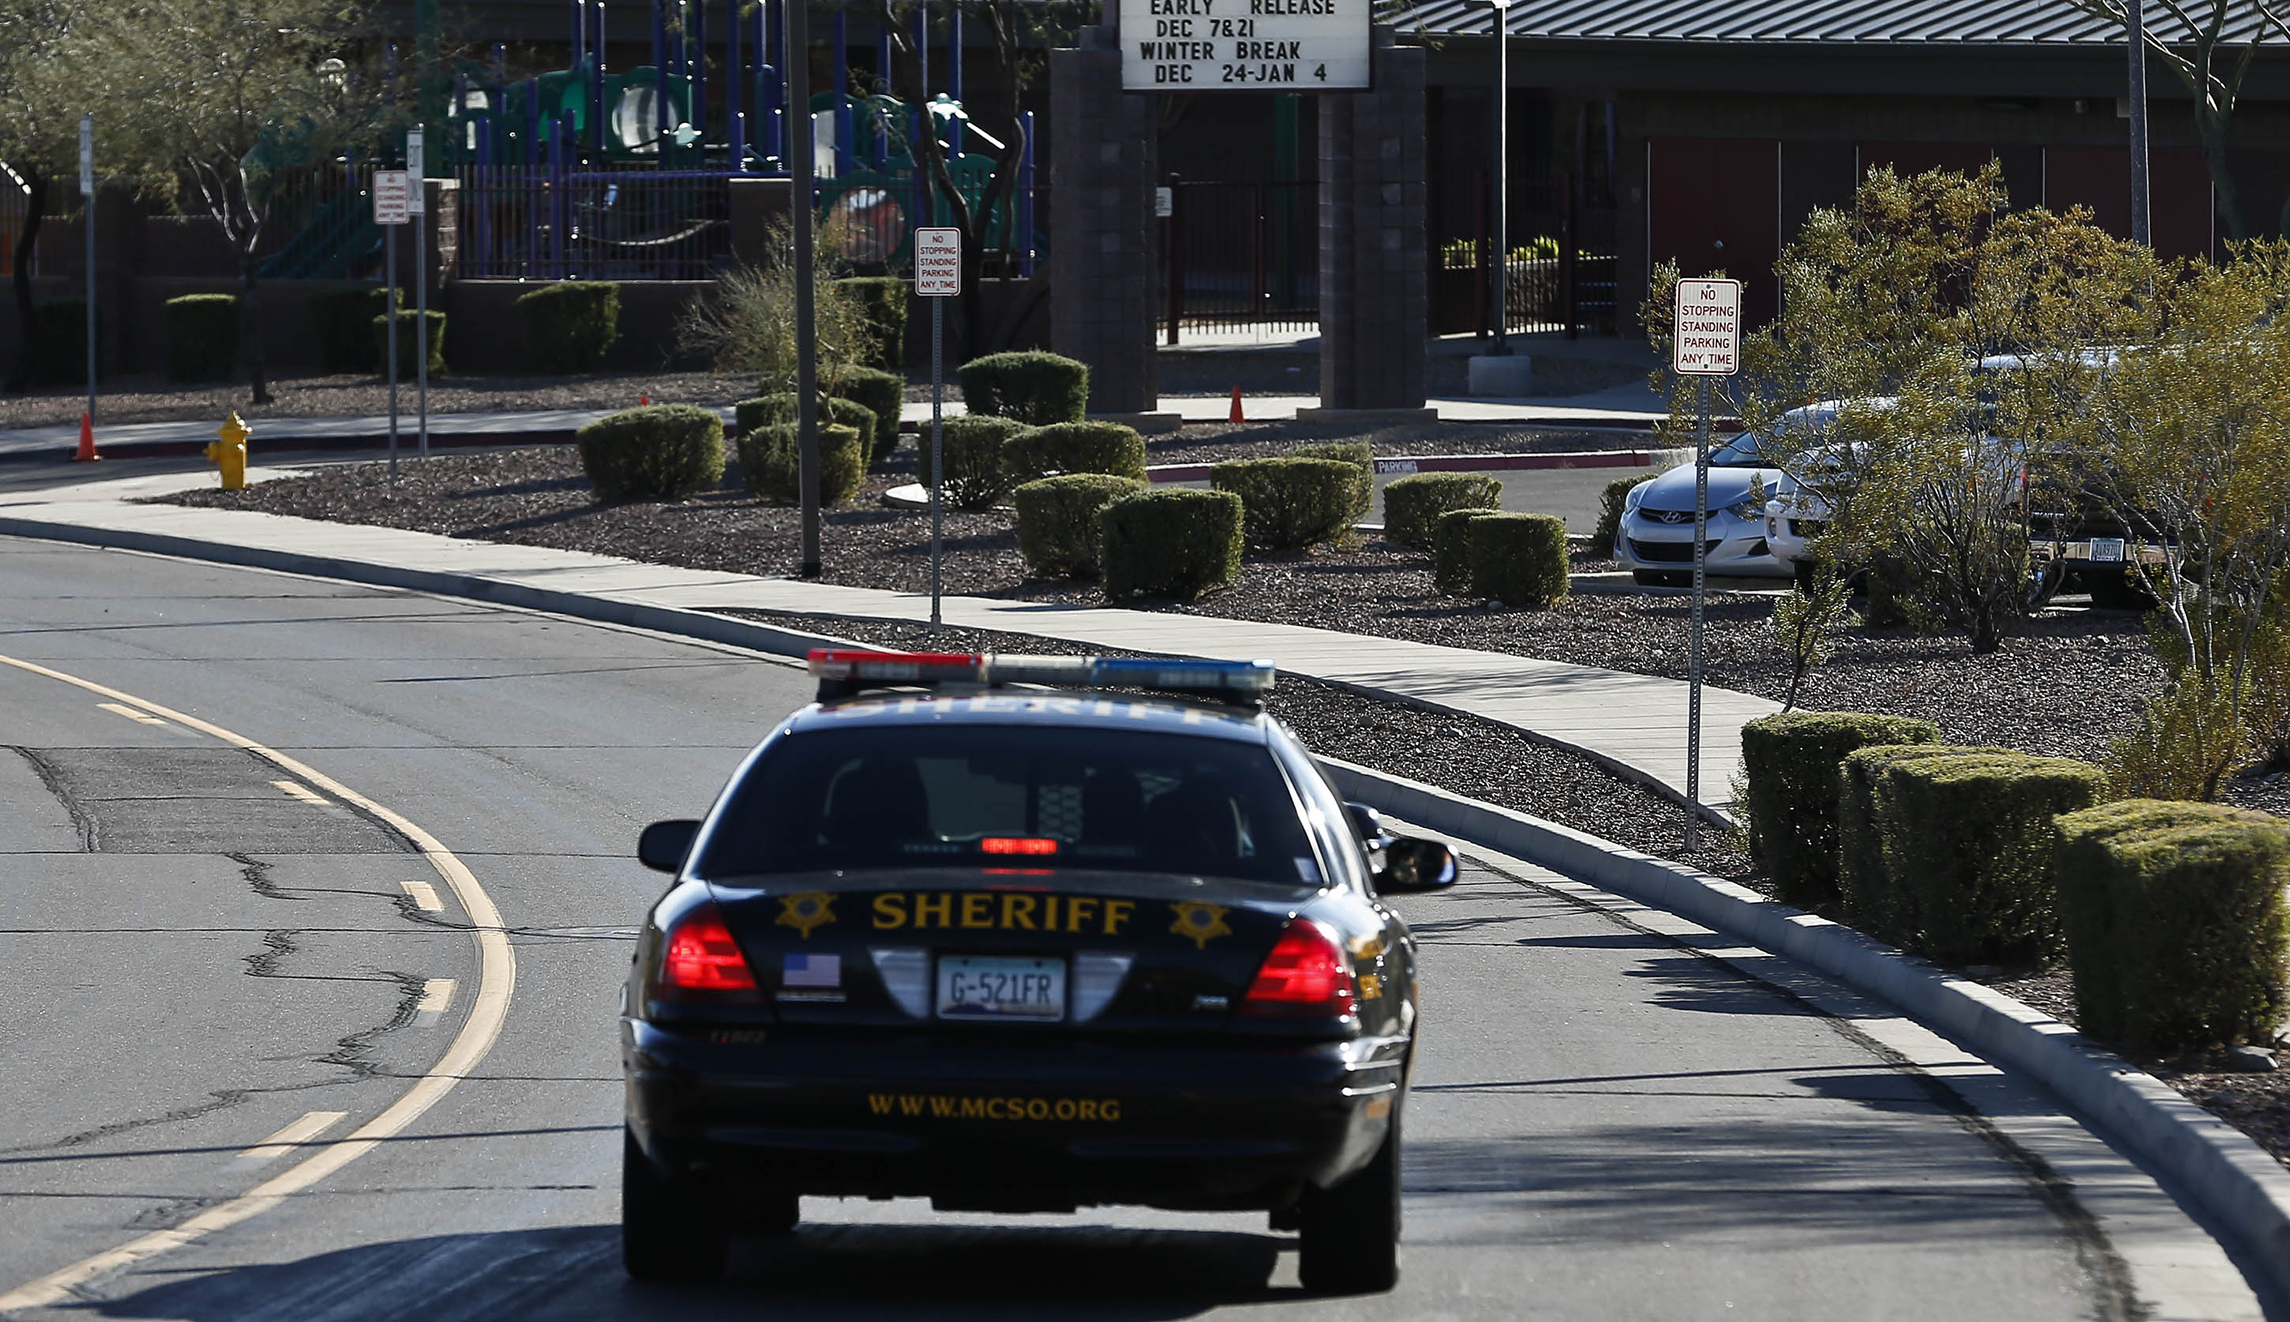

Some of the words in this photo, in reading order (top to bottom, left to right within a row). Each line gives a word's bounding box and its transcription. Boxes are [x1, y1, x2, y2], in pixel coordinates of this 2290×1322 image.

[1150, 0, 1212, 15] EARLY
[1250, 0, 1335, 15] RELEASE
[1156, 19, 1193, 37] DEC
[1210, 19, 1254, 38] 7&21
[1140, 41, 1215, 60] WINTER
[1236, 41, 1301, 60] BREAK
[1155, 64, 1193, 83] DEC
[1222, 64, 1295, 83] 24-JAN
[1313, 63, 1327, 82] 4
[932, 235, 944, 243] NO
[920, 247, 957, 255] STOPPING
[920, 258, 957, 266] STANDING
[922, 269, 954, 277] PARKING
[920, 281, 936, 289] ANY
[939, 281, 956, 289] TIME
[1700, 289, 1717, 300] NO
[1682, 305, 1734, 317] STOPPING
[1681, 321, 1734, 333] STANDING
[1684, 337, 1729, 348] PARKING
[1681, 353, 1704, 364] ANY
[1709, 353, 1733, 364] TIME
[1379, 461, 1418, 473] PARKING
[872, 892, 1136, 935] SHERIFF
[951, 972, 1052, 1006] G-521FR
[868, 1094, 1122, 1121] WWW.MCSO.ORG
